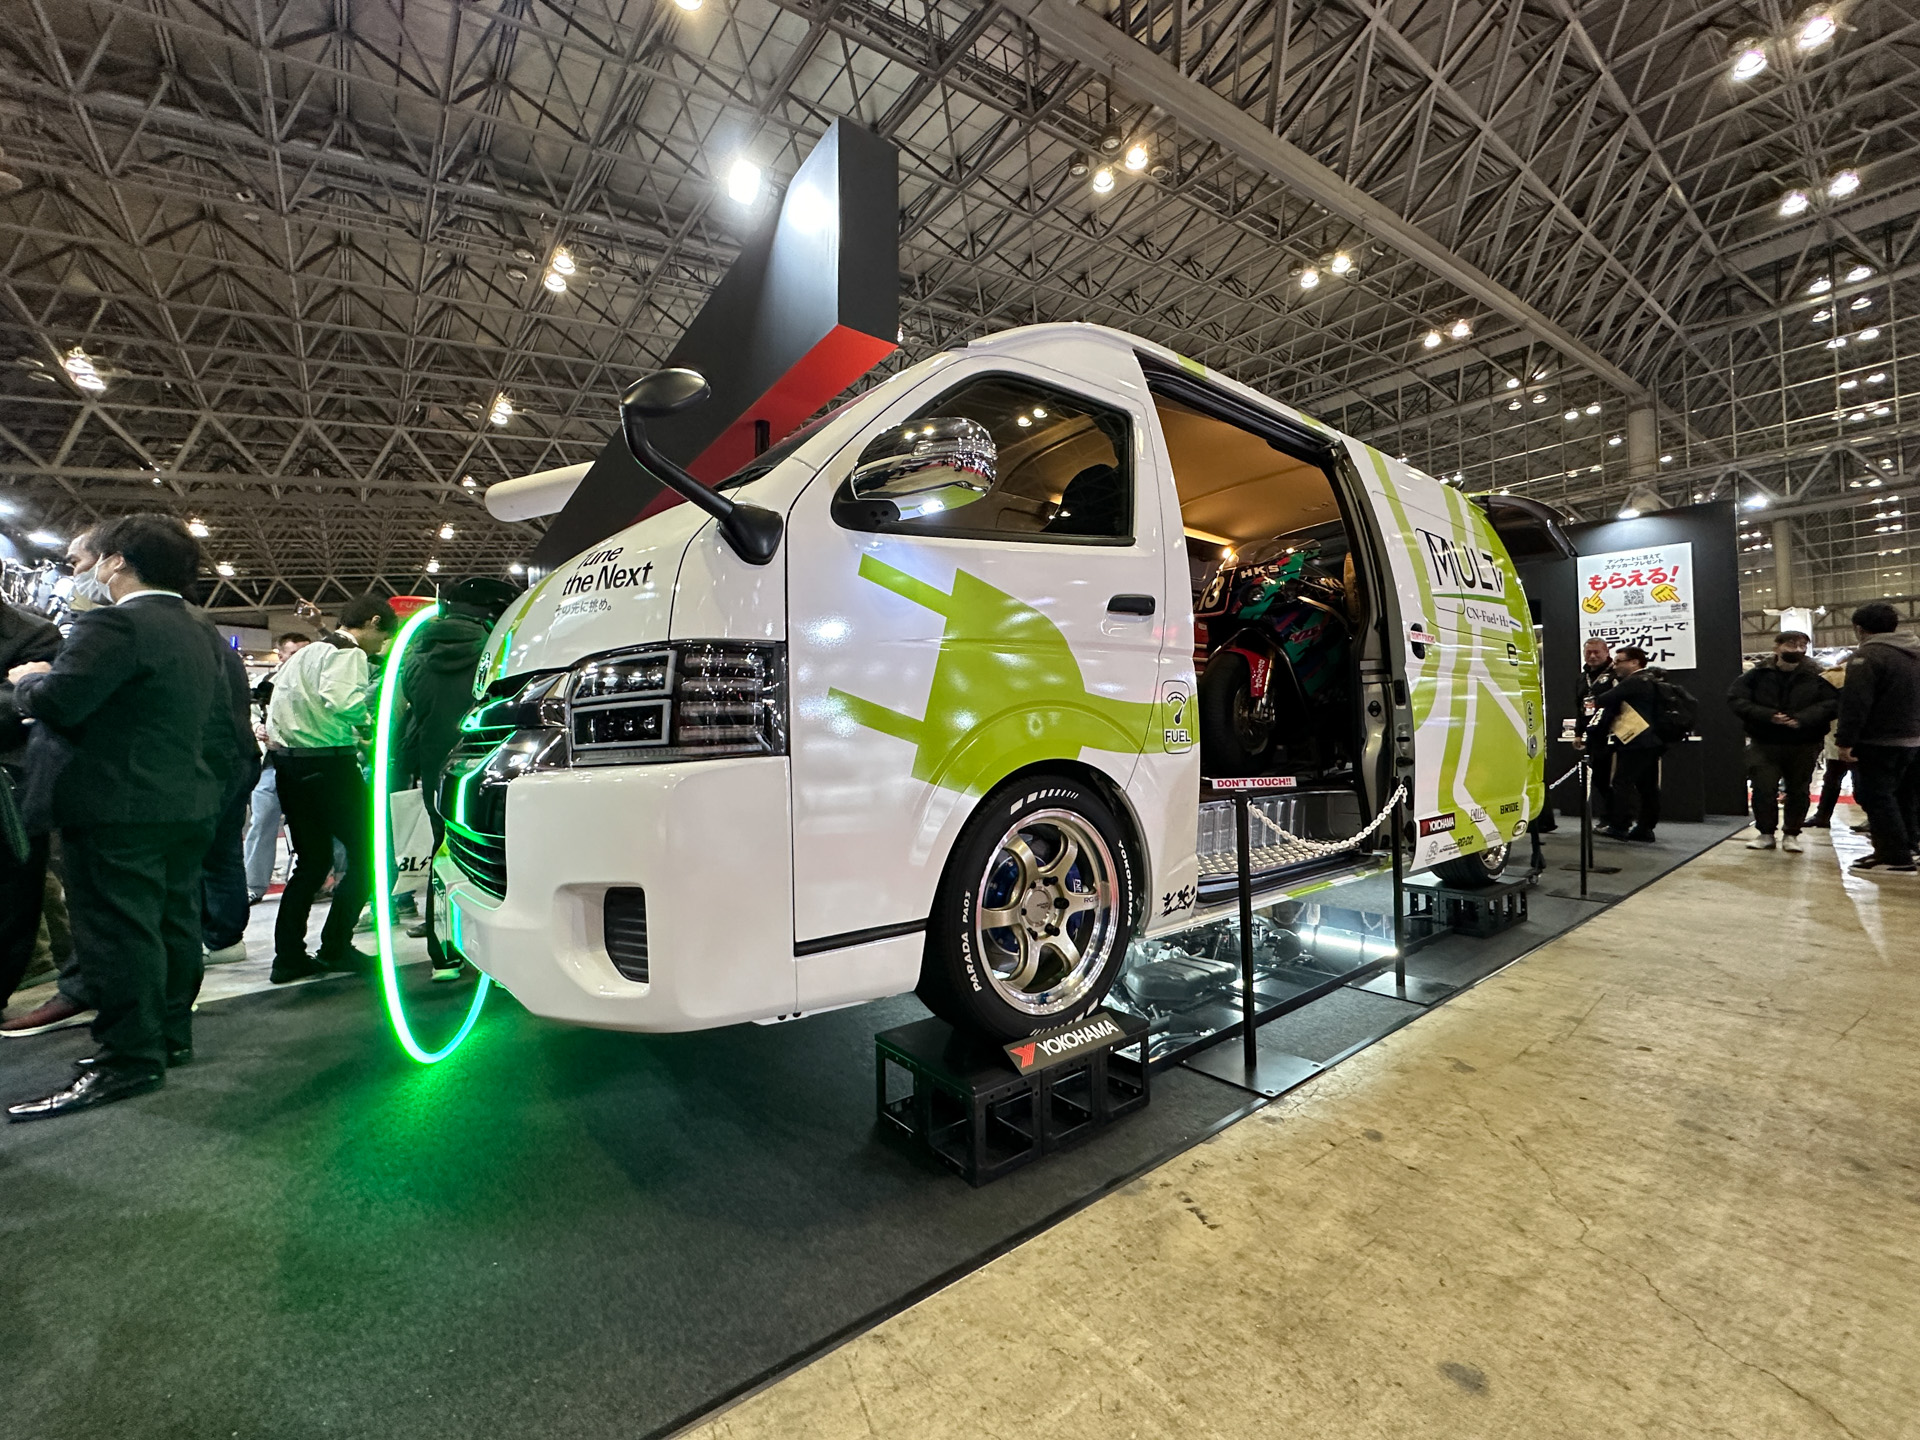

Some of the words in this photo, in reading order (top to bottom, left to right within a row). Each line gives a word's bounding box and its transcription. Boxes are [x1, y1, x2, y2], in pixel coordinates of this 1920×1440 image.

[577, 547, 624, 570] Tune
[562, 571, 594, 596] the
[596, 561, 653, 591] Next
[1240, 564, 1280, 579] HKS
[1589, 622, 1688, 637] WEBアンケートで
[1605, 635, 1672, 649] テッカー
[1165, 730, 1191, 743] FUEL
[1217, 779, 1247, 788] DON'T
[1118, 839, 1133, 927] YOKOHAMA
[961, 931, 982, 992] PARADA
[1036, 1019, 1119, 1057] YOKOHAMA
